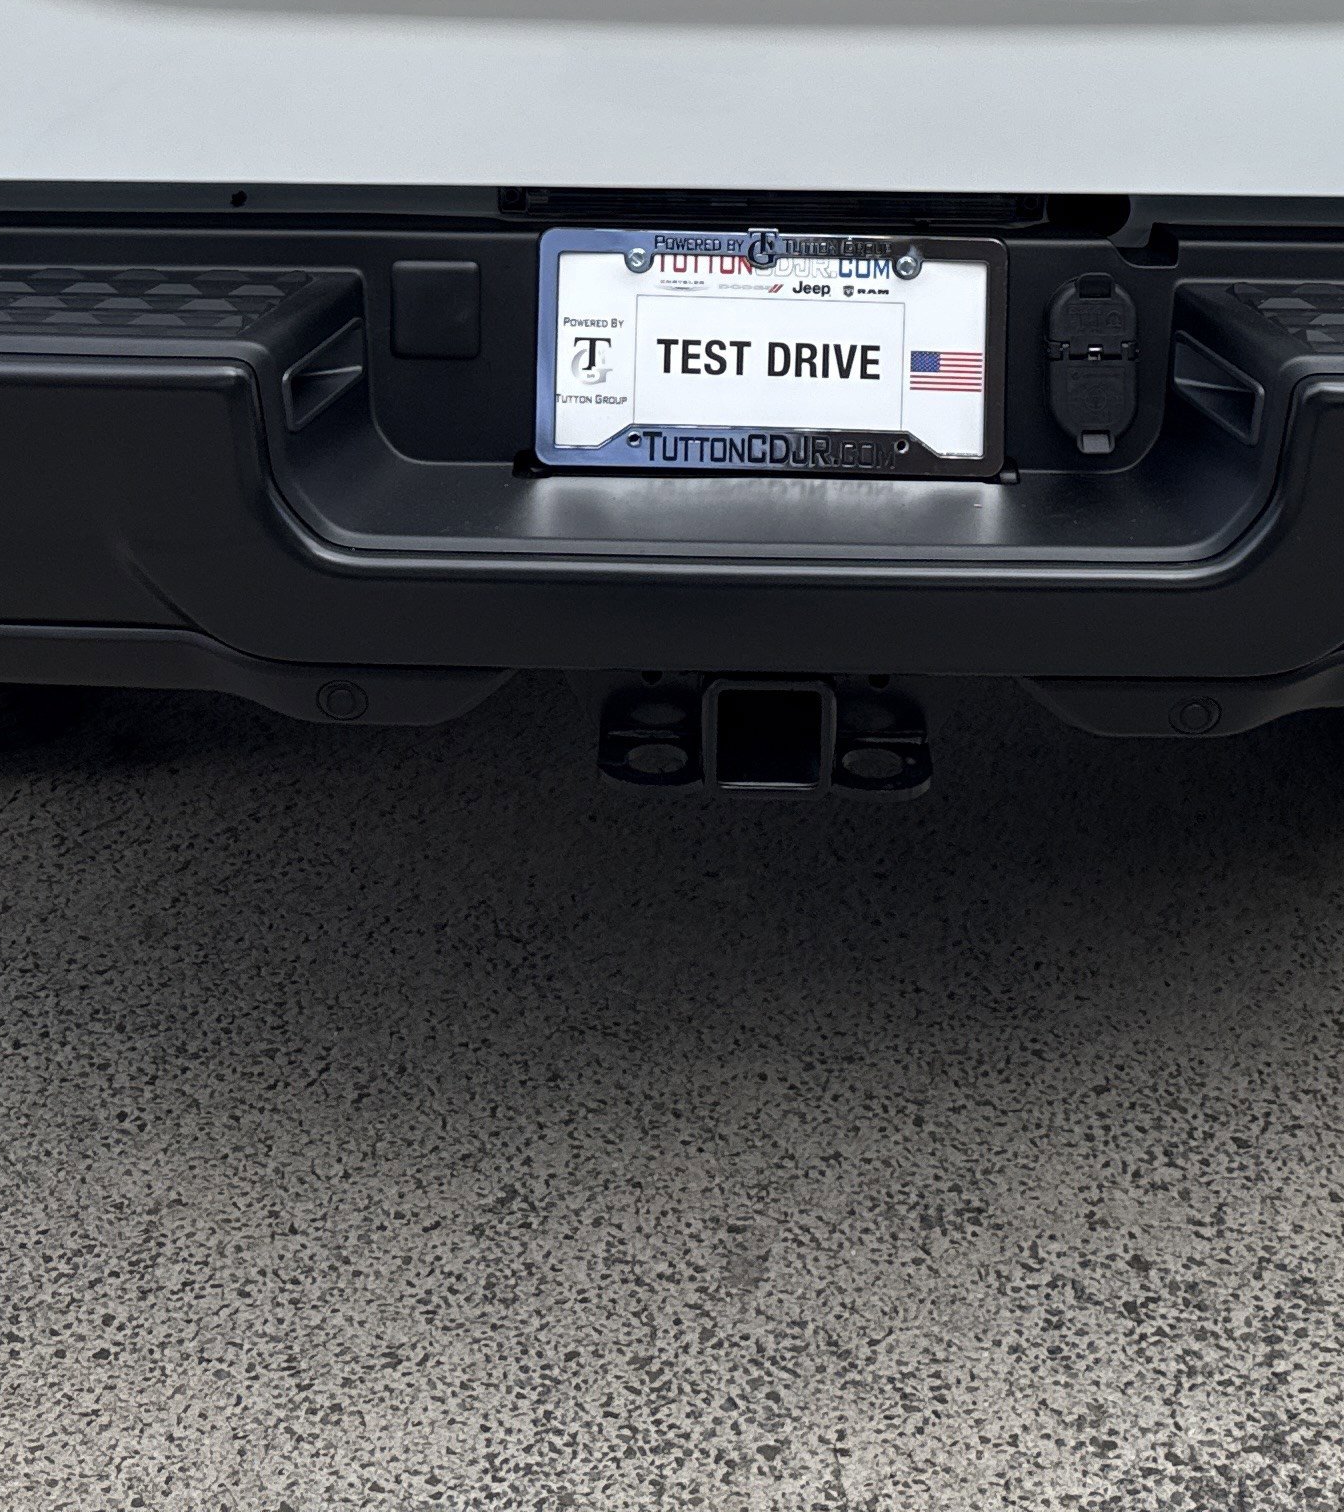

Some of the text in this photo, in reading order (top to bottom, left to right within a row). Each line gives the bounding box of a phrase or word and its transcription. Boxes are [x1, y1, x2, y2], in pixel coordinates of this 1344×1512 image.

[726, 238, 745, 253] BY
[792, 280, 831, 297] Jeep
[656, 338, 881, 380] TEST DRIVE
